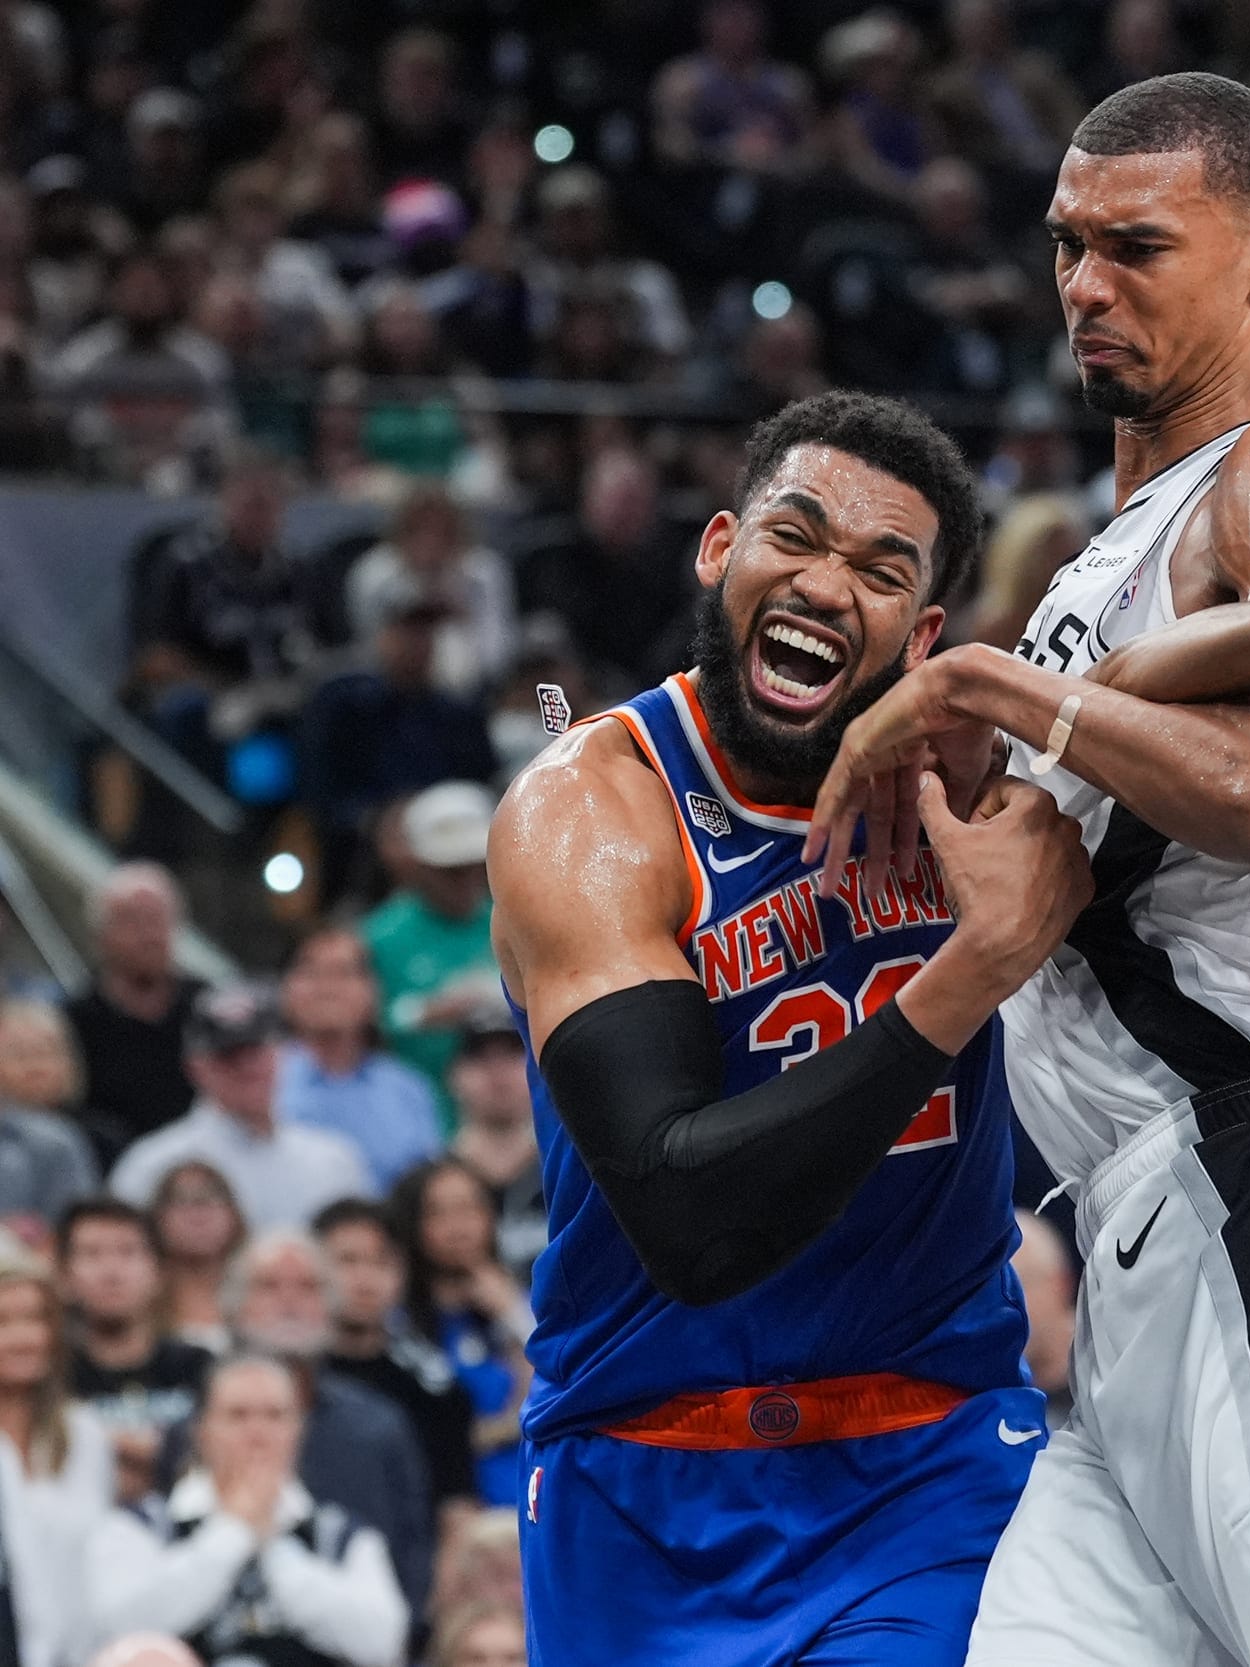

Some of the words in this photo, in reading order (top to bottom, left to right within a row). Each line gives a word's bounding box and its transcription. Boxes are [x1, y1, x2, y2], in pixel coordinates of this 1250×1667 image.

[691, 798, 721, 814] USA
[695, 813, 728, 830] 250
[693, 875, 828, 1004] NEW
